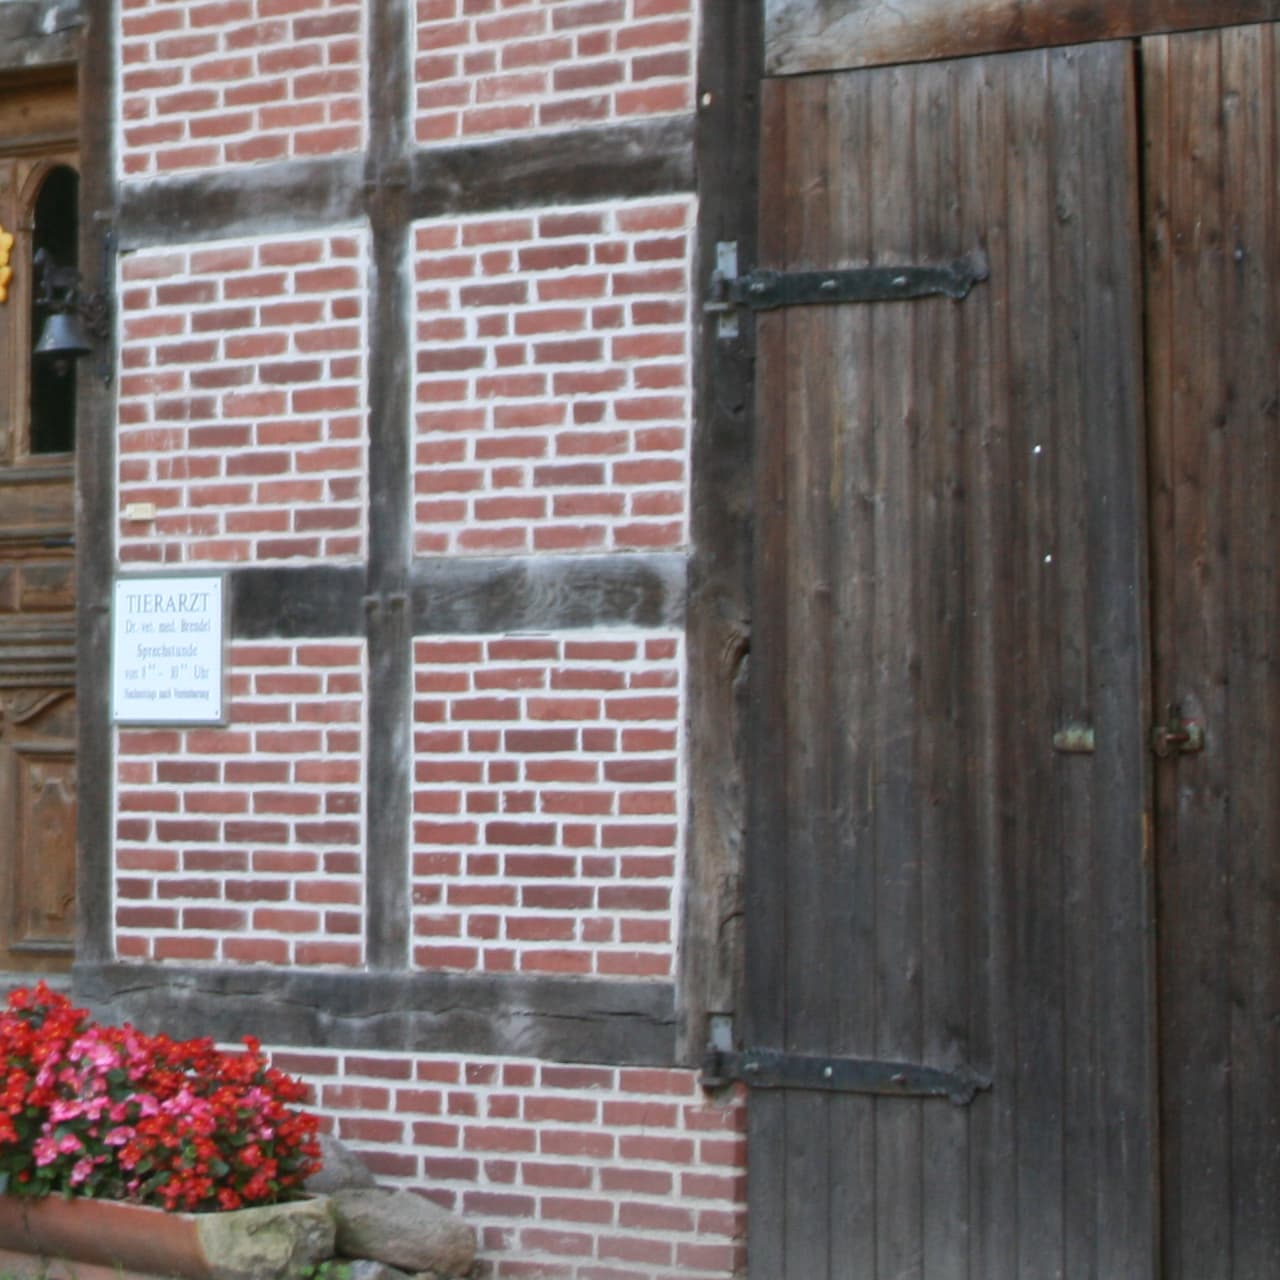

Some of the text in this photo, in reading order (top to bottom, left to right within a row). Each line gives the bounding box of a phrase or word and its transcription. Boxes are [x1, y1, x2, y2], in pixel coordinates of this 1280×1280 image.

[126, 593, 209, 613] TIERARZT
[126, 619, 137, 633] Dr.
[136, 642, 198, 660] Sprechstunde
